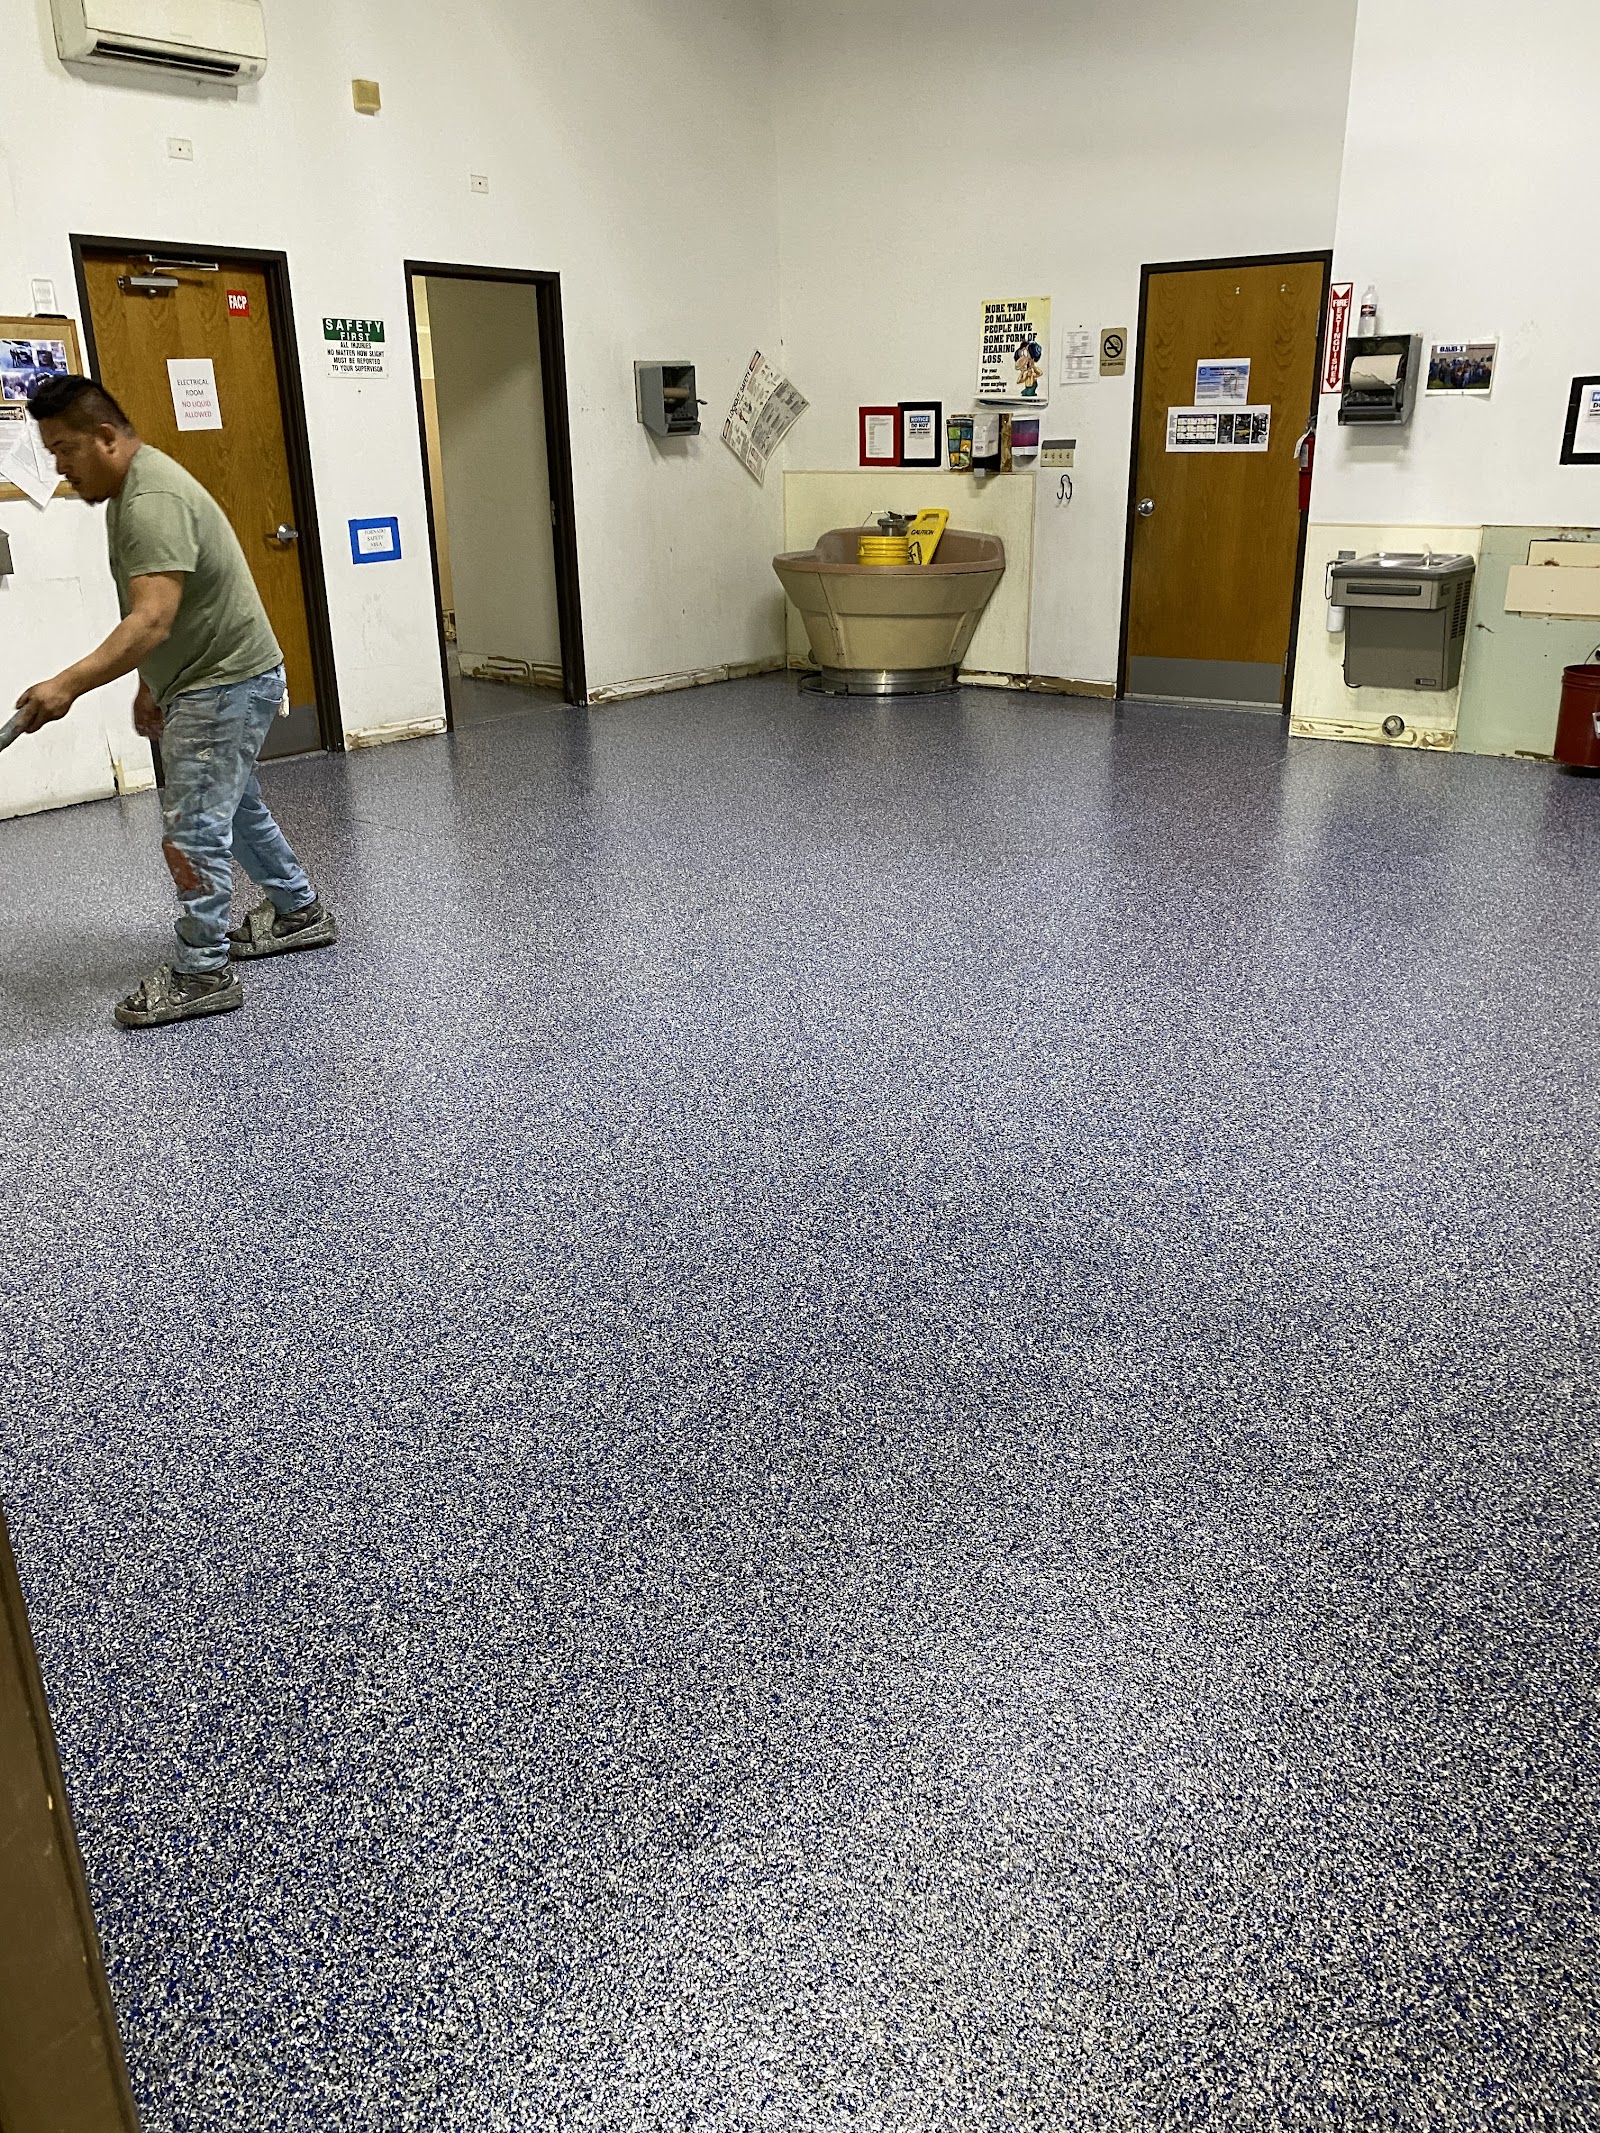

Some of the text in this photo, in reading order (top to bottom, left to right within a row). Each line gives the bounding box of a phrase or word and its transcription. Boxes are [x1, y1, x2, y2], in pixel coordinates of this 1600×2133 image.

[228, 295, 247, 309] FACP
[1333, 299, 1348, 307] FIRE
[985, 303, 1027, 313] MORE THAN
[985, 313, 1025, 323] 20 MILLION
[325, 319, 381, 332] SAFETY
[985, 323, 1032, 333] PEOPLE HAVE
[340, 332, 370, 341] FIRST
[984, 333, 1037, 344] SOME FORM OF
[983, 344, 1015, 353] HEARING
[1329, 307, 1343, 383] EXTINGUISHER
[982, 355, 1003, 363] LOSS.
